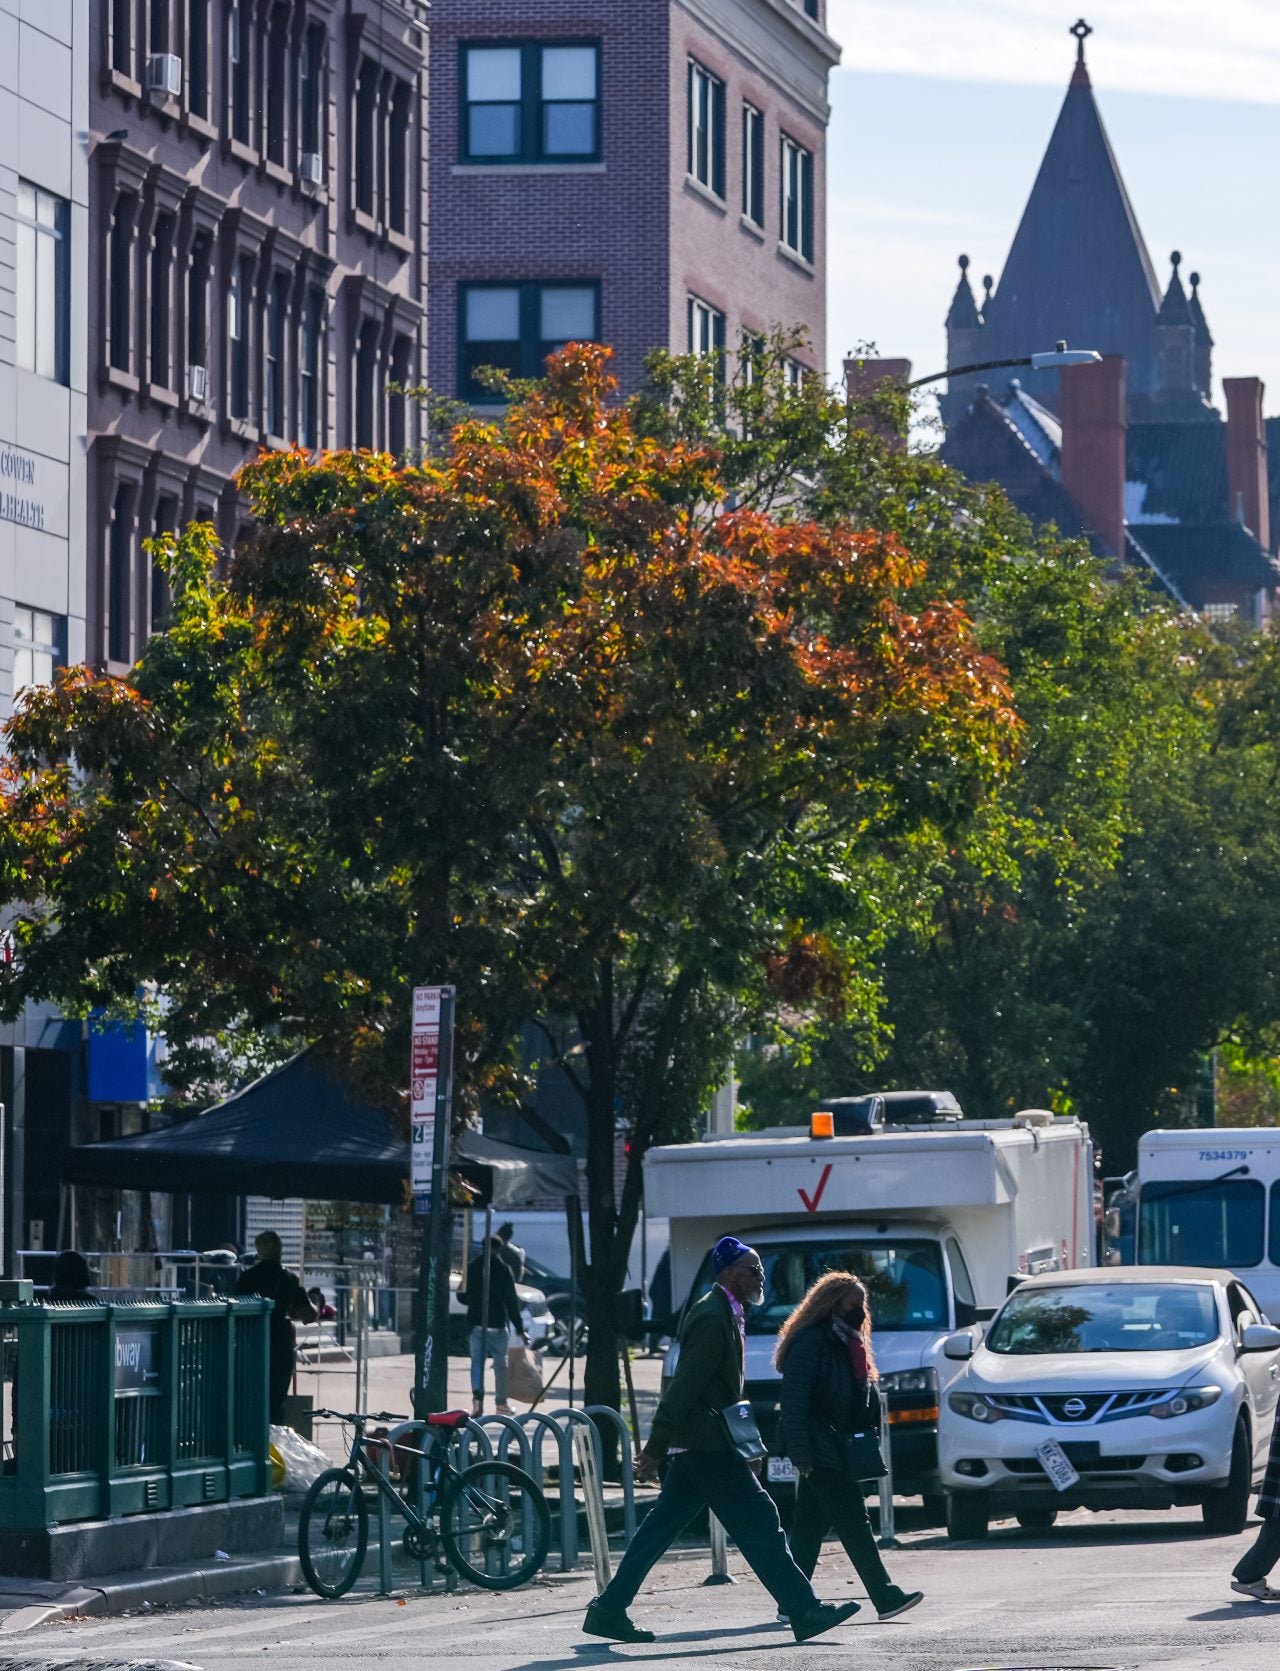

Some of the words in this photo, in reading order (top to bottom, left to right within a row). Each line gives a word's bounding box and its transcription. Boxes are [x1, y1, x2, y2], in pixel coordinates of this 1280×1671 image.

[6, 493, 44, 529] HEALTH
[416, 992, 423, 1001] NO
[414, 1036, 422, 1046] NO
[415, 1125, 422, 1142] 2
[1199, 1150, 1247, 1161] 7534379
